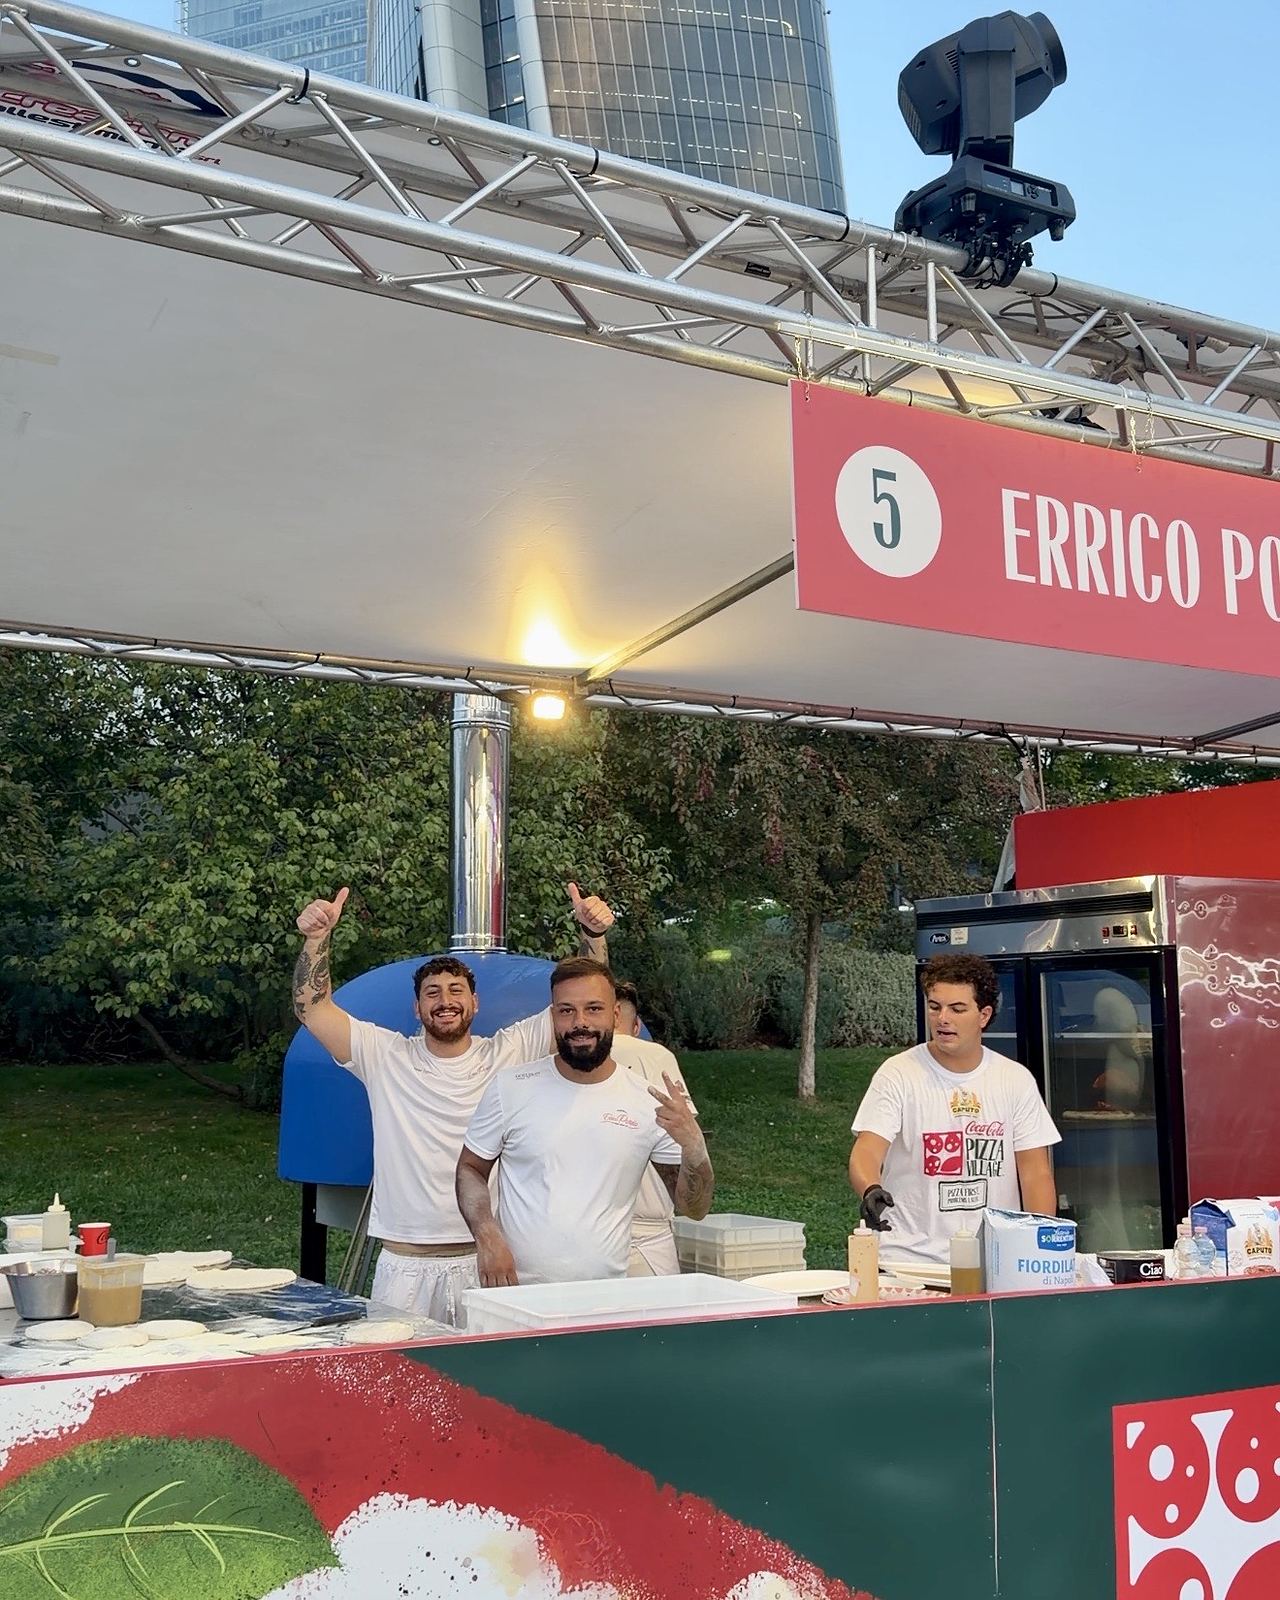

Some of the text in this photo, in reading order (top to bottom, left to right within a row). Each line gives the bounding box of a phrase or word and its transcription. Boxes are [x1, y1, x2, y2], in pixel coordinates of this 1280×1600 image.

[872, 468, 901, 549] 5
[1001, 488, 1200, 609] ERRICO
[965, 1138, 1004, 1160] PIZZA
[966, 1160, 1003, 1177] VILLAGE
[1017, 1258, 1076, 1274] FIORDILA
[1139, 1262, 1163, 1276] Ciao
[1042, 1276, 1052, 1285] di
